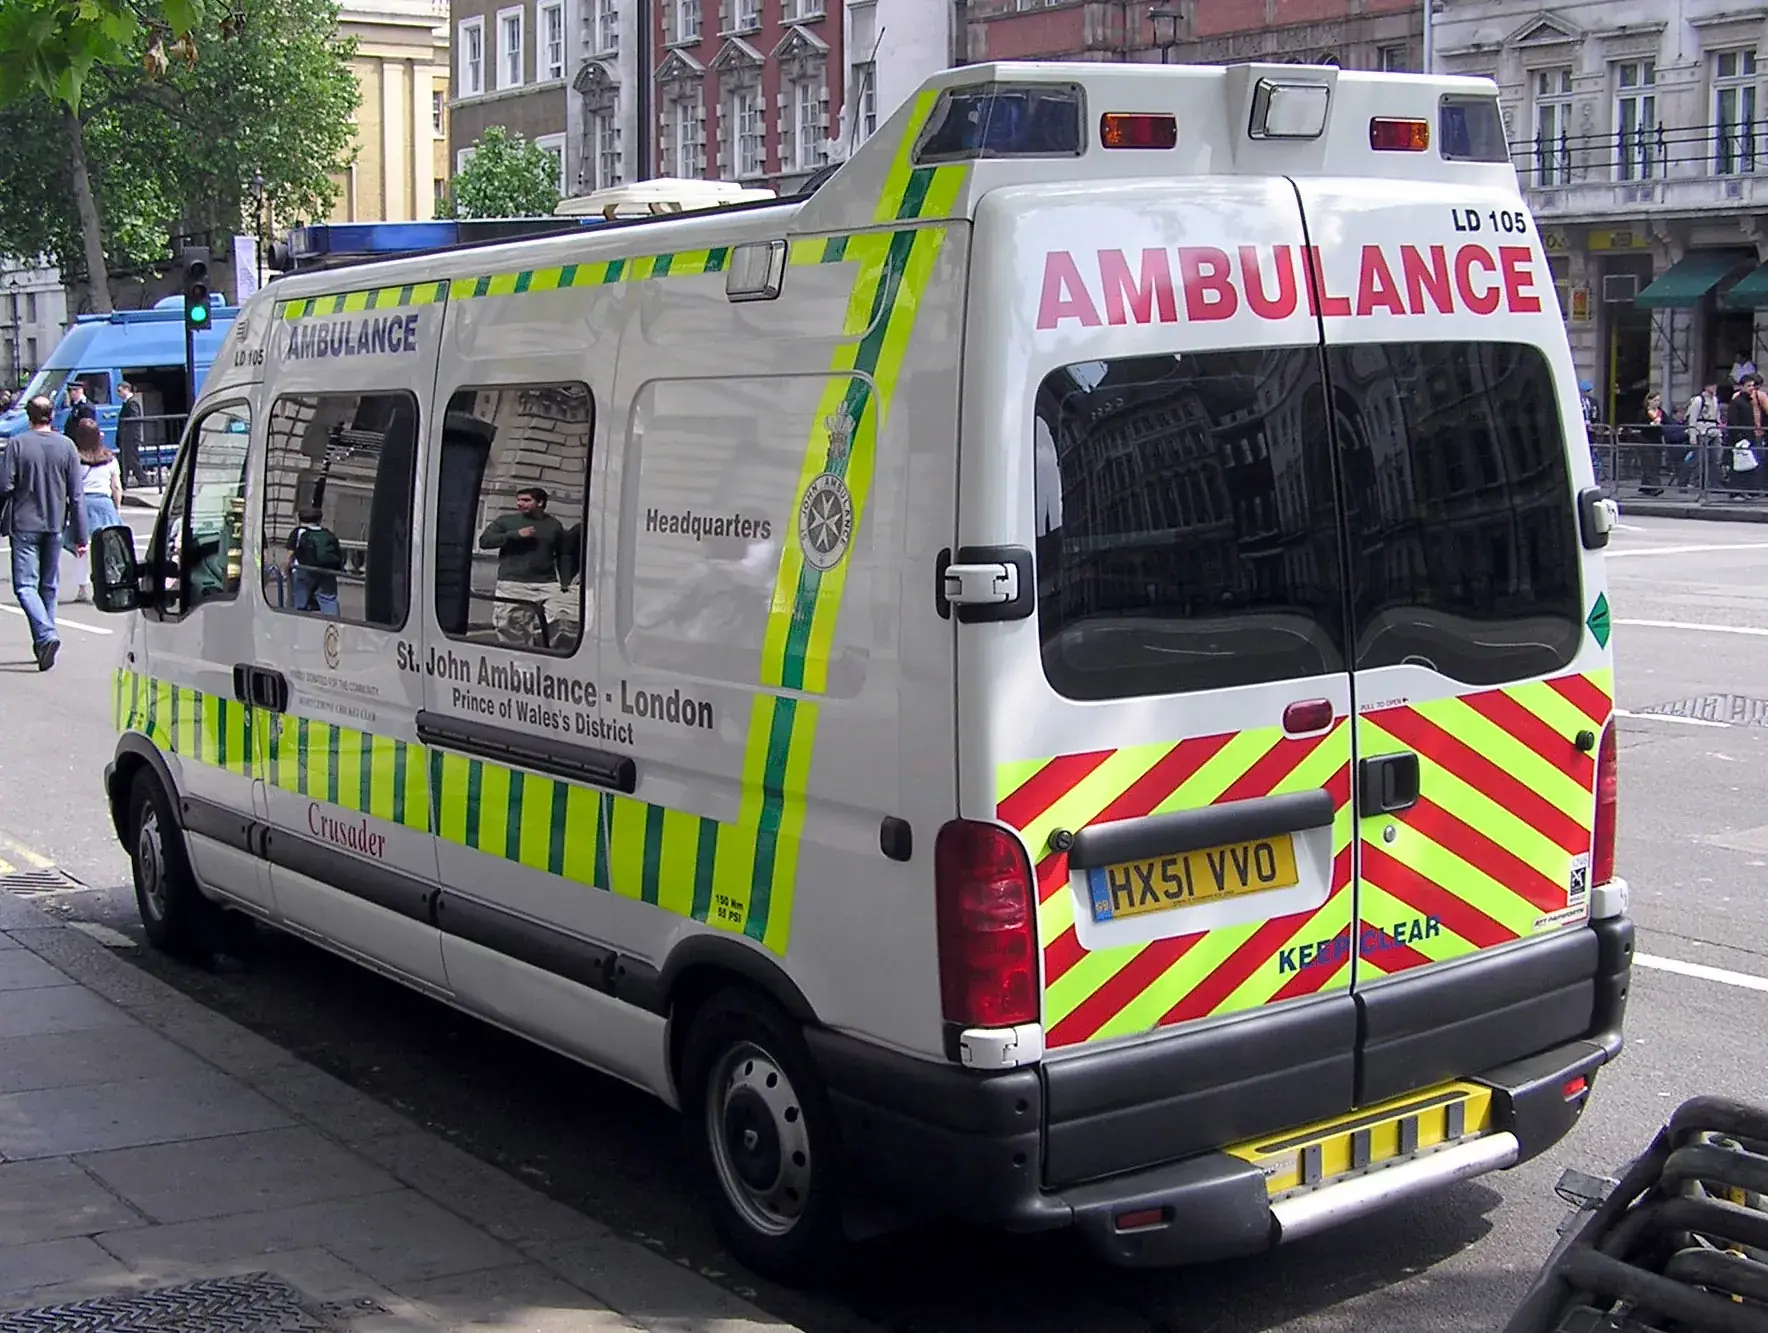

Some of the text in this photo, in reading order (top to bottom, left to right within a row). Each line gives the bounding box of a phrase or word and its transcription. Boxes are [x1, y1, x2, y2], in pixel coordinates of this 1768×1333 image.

[1452, 208, 1526, 234] LD 105
[1036, 243, 1543, 330] AMBULANCE
[235, 349, 264, 367] LD 105
[287, 314, 419, 360] AMBULANCE
[646, 508, 772, 541] Headquarters
[801, 483, 819, 515] JOHN
[824, 476, 852, 546] AMBULANCE
[396, 640, 420, 673] St.
[426, 647, 471, 683] John
[477, 655, 597, 708] Ambulance
[621, 679, 714, 729] London
[452, 687, 634, 745] Prince of Wales's District
[308, 802, 386, 858] Crusader
[1108, 842, 1277, 910] HX51 VVO
[1279, 914, 1441, 974] KEEP CLEAR
